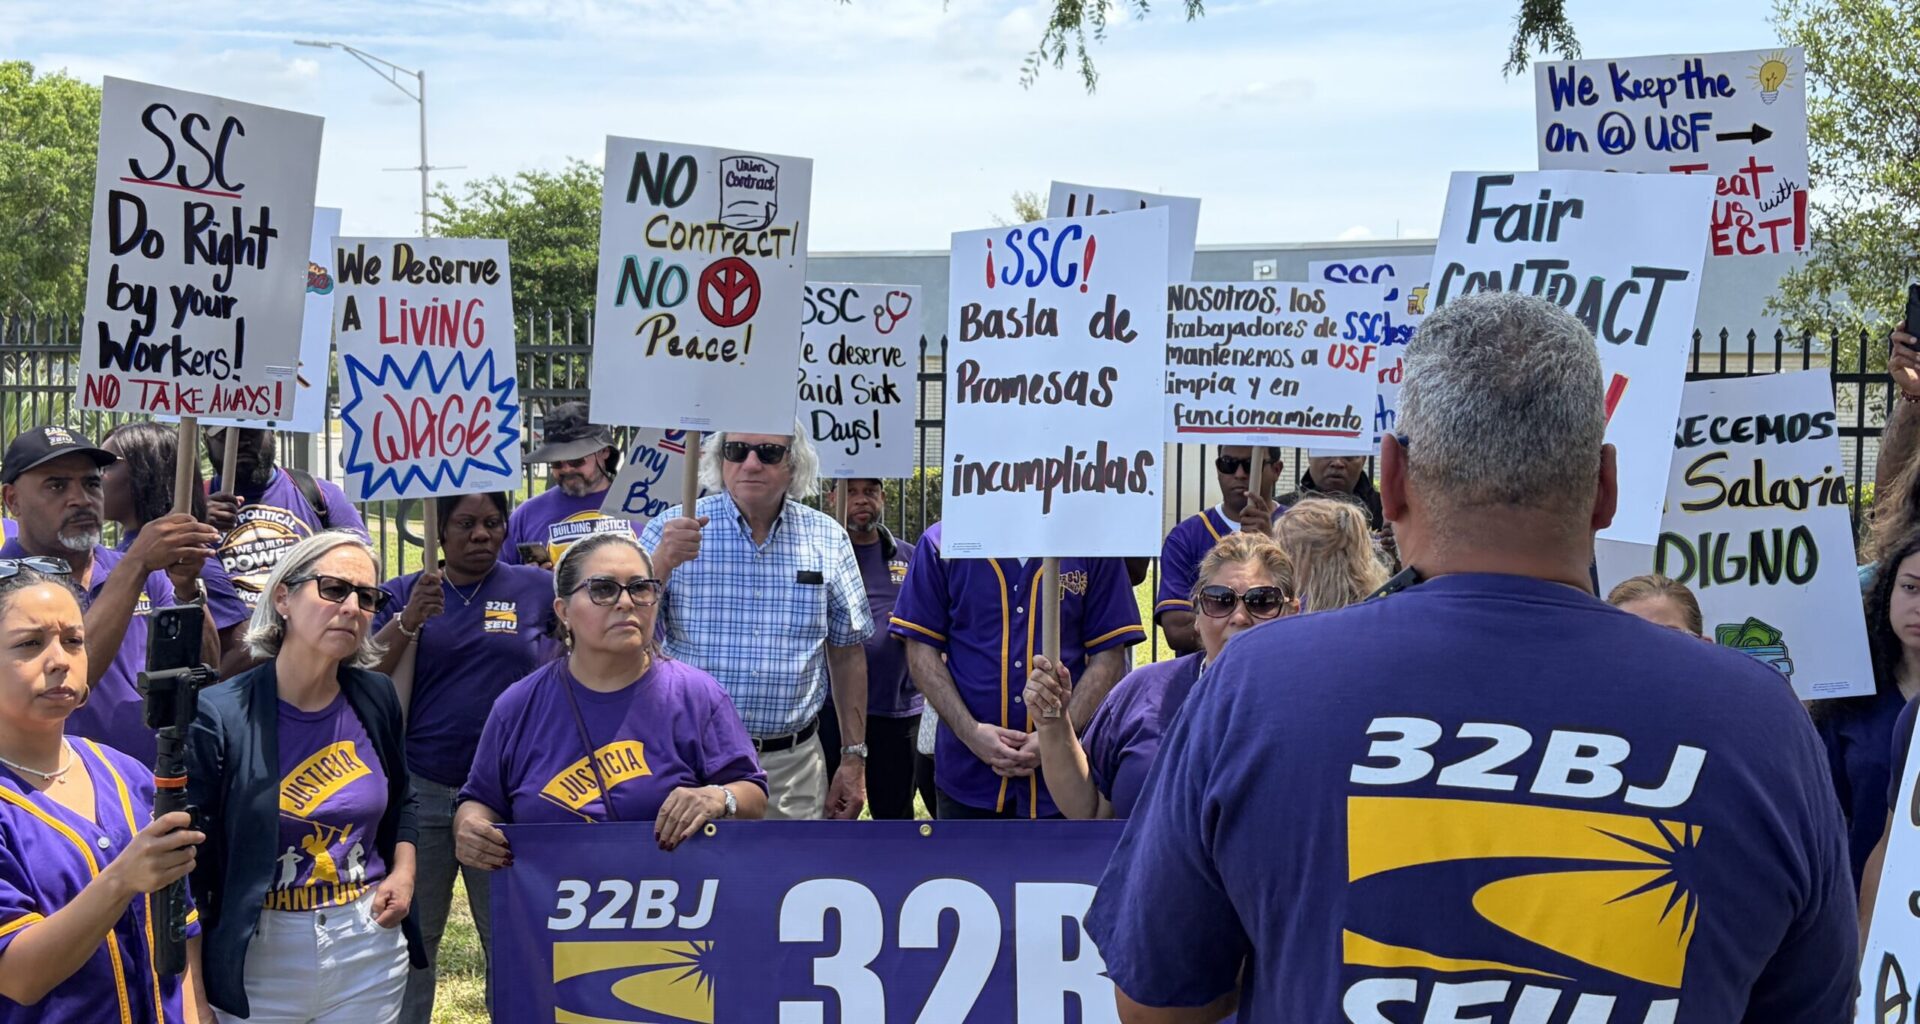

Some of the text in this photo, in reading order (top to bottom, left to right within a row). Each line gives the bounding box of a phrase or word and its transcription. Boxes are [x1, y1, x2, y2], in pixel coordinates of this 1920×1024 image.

[1547, 65, 1600, 112] We
[1677, 58, 1737, 100] the
[128, 103, 245, 192] SSC
[1597, 111, 1636, 155] @
[1645, 111, 1713, 153] USF
[626, 151, 698, 209] NO
[725, 174, 775, 191] Contract
[736, 159, 768, 174] Union
[1467, 173, 1583, 244] Fair
[1758, 177, 1799, 213] with
[109, 190, 278, 293] Do Right
[1711, 190, 1808, 256] ECT!
[337, 244, 382, 285] We
[391, 242, 501, 285] Deserve
[985, 224, 1097, 293] ¡SSC!
[106, 264, 239, 337] by your
[613, 254, 690, 310] NO
[802, 285, 866, 325] SSC
[1289, 287, 1327, 313] los
[341, 295, 362, 332] A
[959, 294, 1139, 344] Basta de
[1166, 313, 1308, 347] trabajadores
[1313, 316, 1338, 338] de
[1342, 311, 1383, 344] SSC
[98, 316, 245, 382] Workers!
[634, 312, 753, 366] Peace!
[800, 331, 906, 368] e deserve
[1165, 342, 1295, 368] mantenemos
[1301, 348, 1318, 365] a
[1327, 343, 1378, 373] USF
[83, 373, 121, 410] NO
[128, 378, 204, 415] TAKE
[850, 373, 902, 405] Sick
[955, 359, 1119, 408] Promesas
[1165, 370, 1300, 400] limpia y en
[373, 393, 492, 465] WAGE
[810, 408, 882, 456] Days!
[951, 440, 1155, 515] incumplidas.
[237, 508, 297, 531] POLITICAL
[552, 519, 627, 538] BUILDING JUSTICE
[222, 545, 290, 573] POWE
[233, 538, 285, 555] WE BUILD
[1655, 525, 1819, 589] DIGNO
[484, 620, 518, 630] SEIU
[485, 600, 517, 611] 32BJ
[281, 748, 361, 811] JUSTICIA
[1348, 716, 1707, 809] 32BJ
[547, 879, 720, 930] 32BJ
